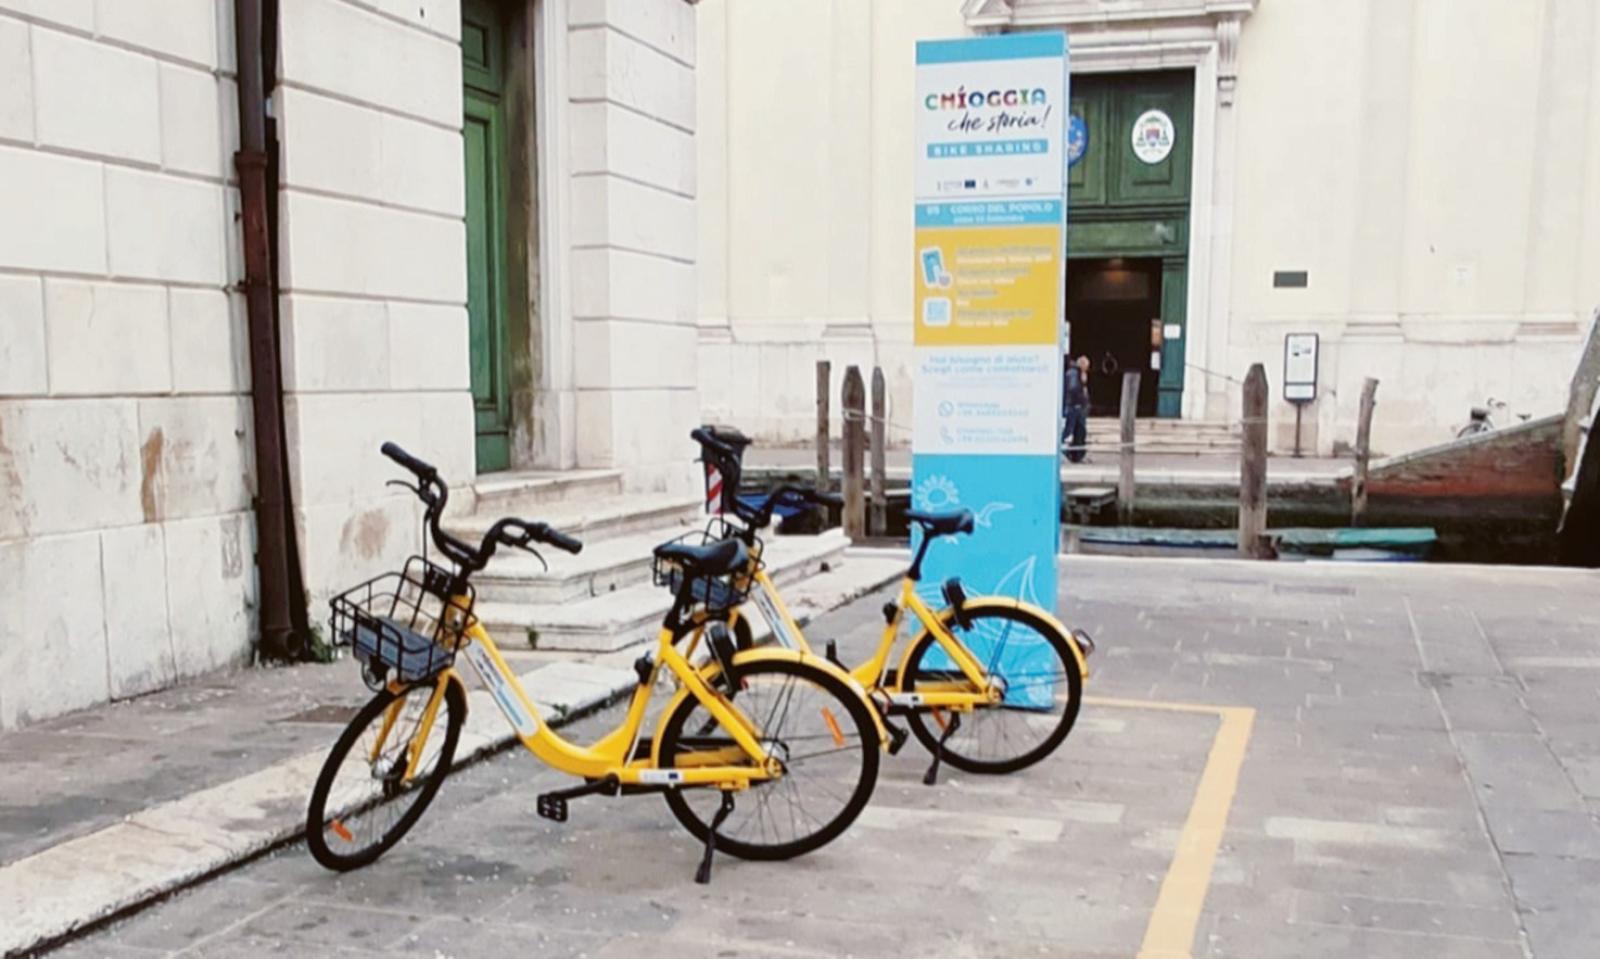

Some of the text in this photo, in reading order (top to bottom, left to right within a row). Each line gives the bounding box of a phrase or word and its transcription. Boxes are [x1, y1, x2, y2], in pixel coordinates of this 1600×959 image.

[947, 104, 1052, 133] che storia!
[934, 142, 1041, 156] BIKE SHARING
